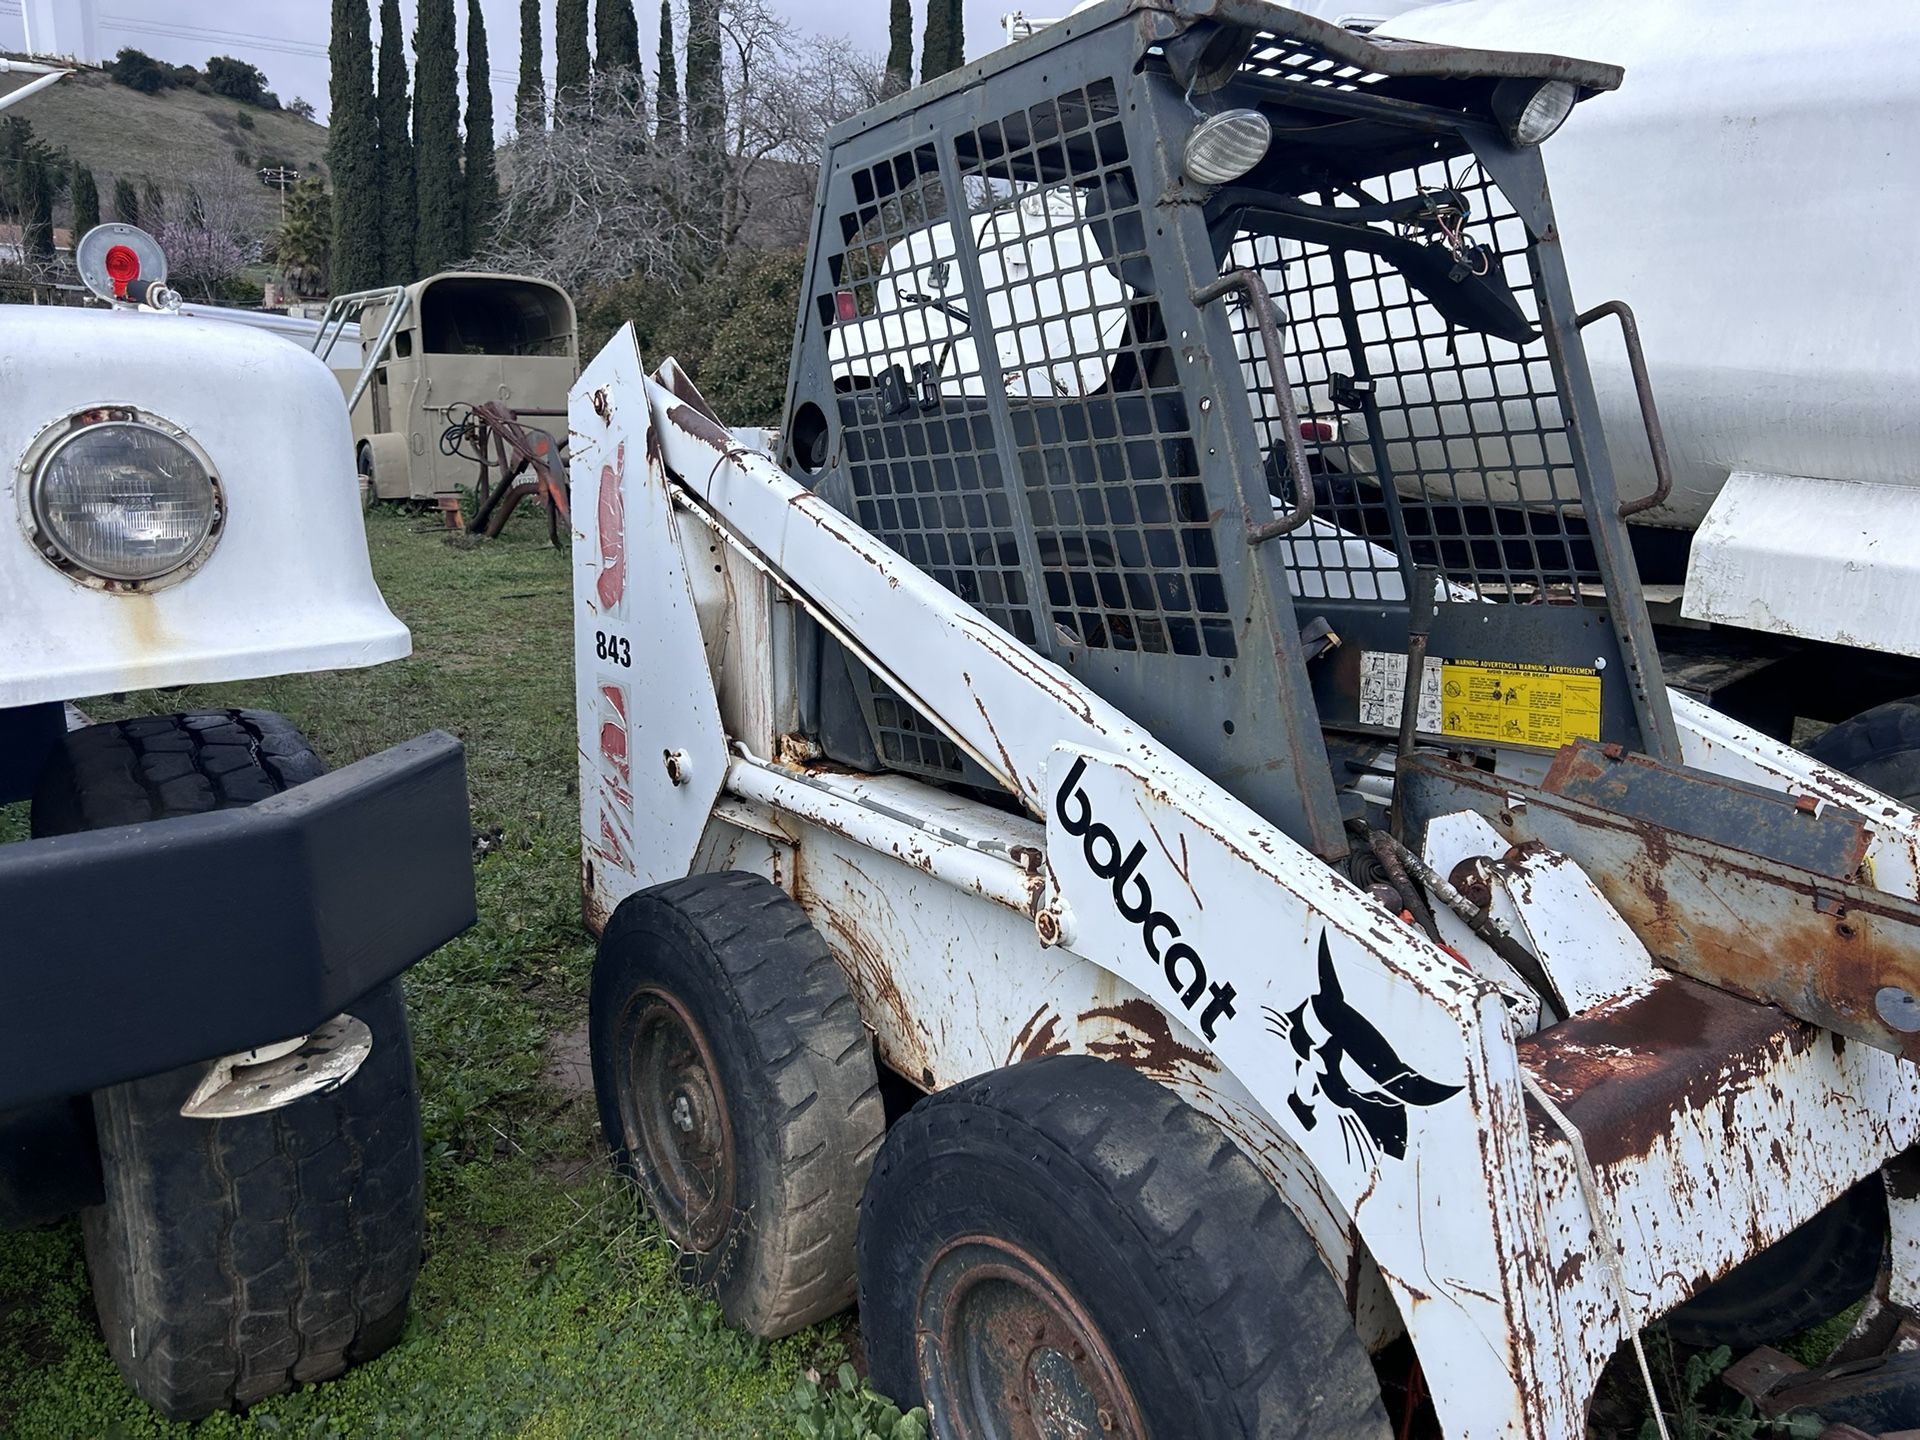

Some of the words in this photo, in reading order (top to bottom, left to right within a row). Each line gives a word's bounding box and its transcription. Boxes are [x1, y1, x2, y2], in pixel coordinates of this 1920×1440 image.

[596, 630, 632, 668] 843
[1455, 659, 1479, 667] WARNING
[1480, 661, 1517, 669] ADVERTENCIA
[1548, 666, 1596, 675] AVERTISSEMENT
[1056, 756, 1237, 1043] bobcat
